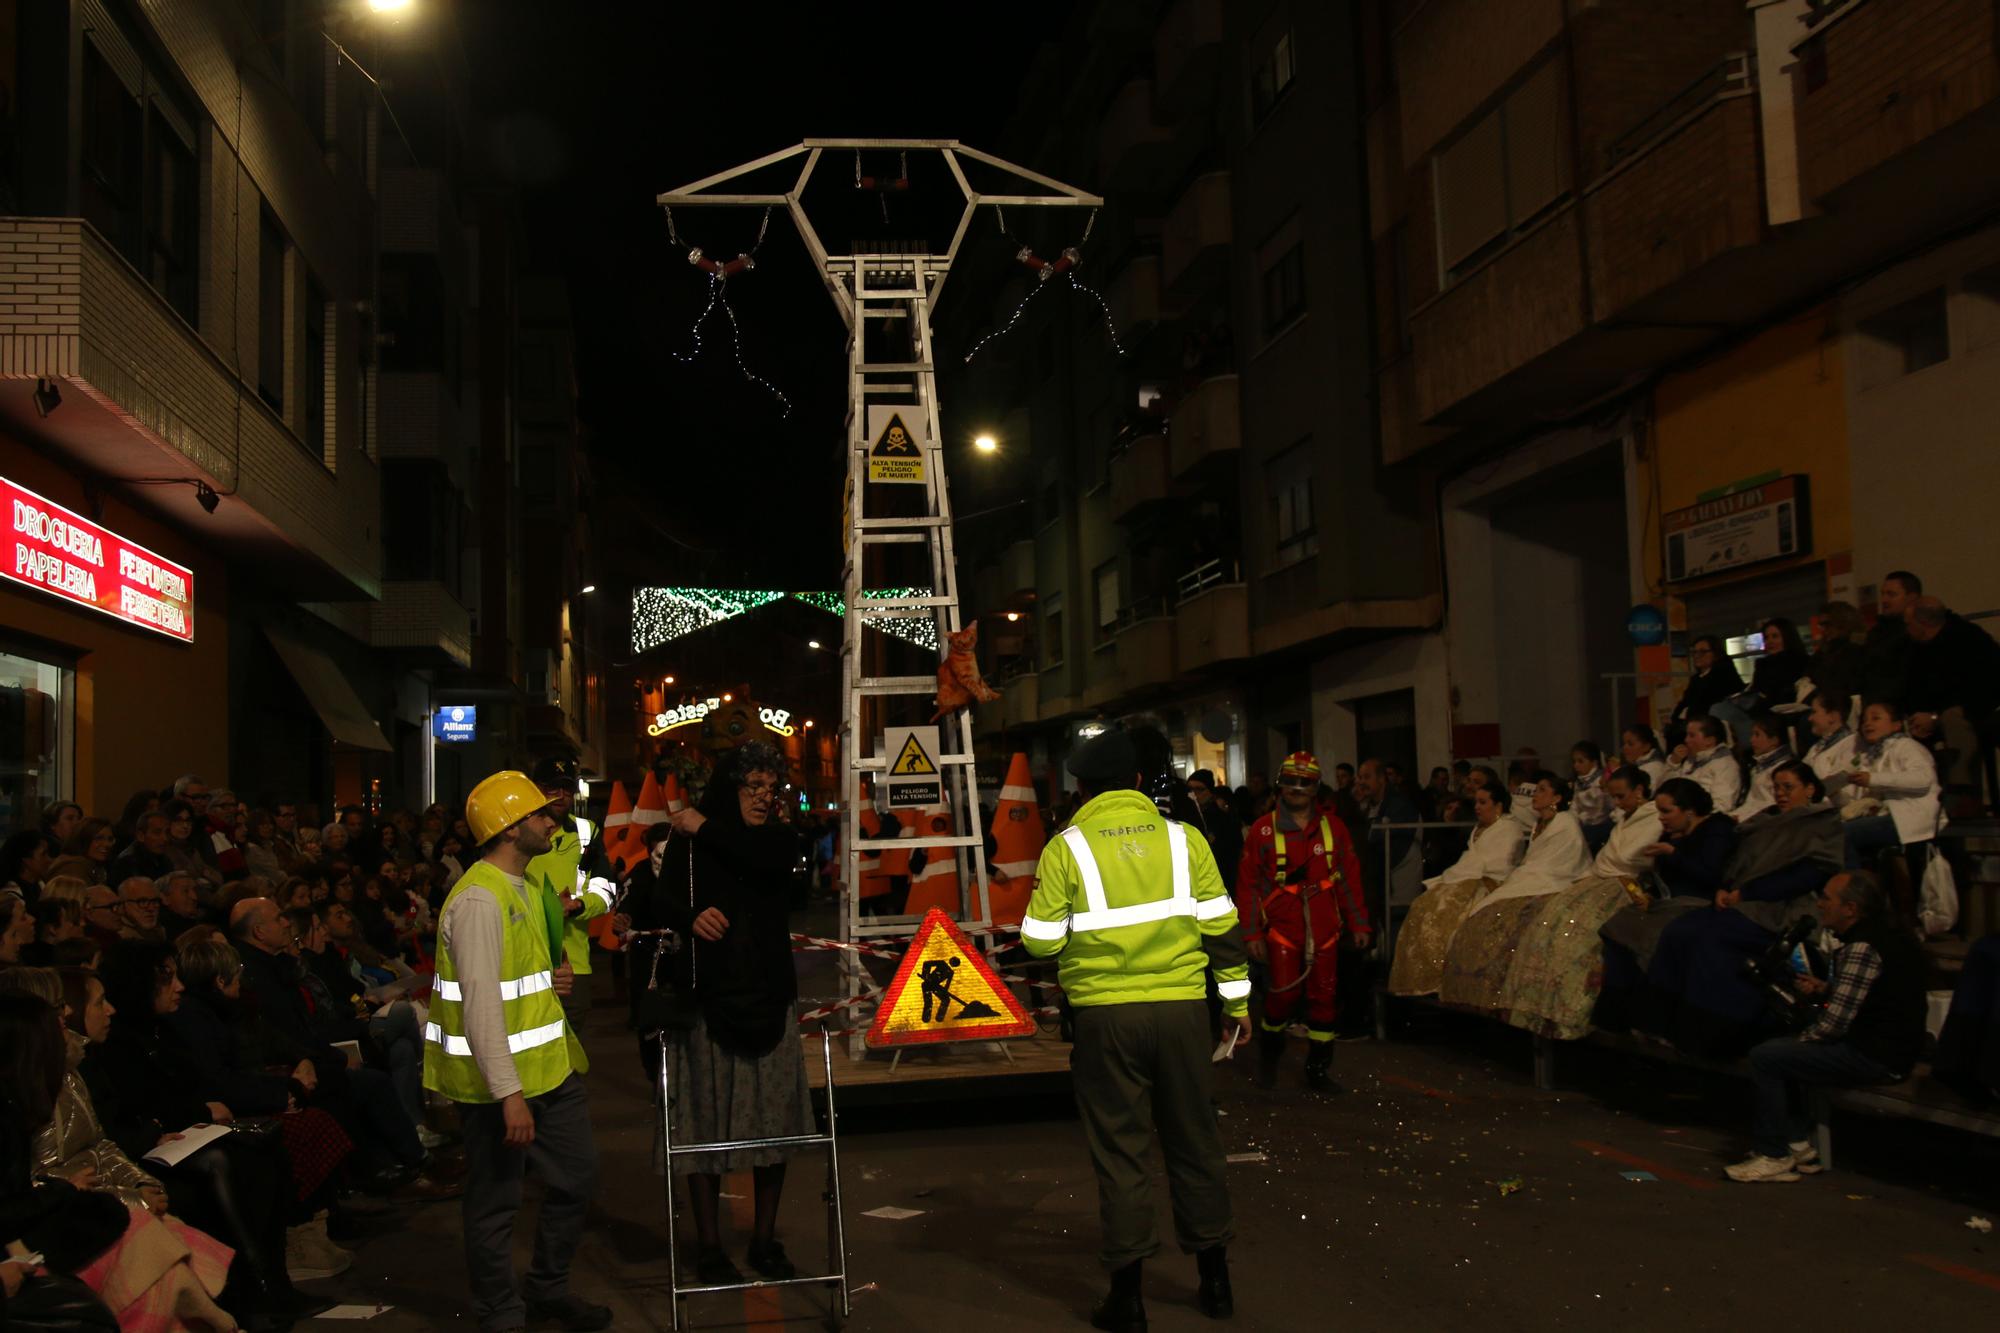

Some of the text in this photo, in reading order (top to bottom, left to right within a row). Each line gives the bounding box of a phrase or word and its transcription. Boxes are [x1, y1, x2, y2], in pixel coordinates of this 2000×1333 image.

[13, 499, 187, 603] DROGUERIA PERFUMERIA
[16, 542, 186, 634] PAPELERIA FERRETERIA
[443, 722, 474, 731] Allianz
[447, 733, 469, 741] Seguros
